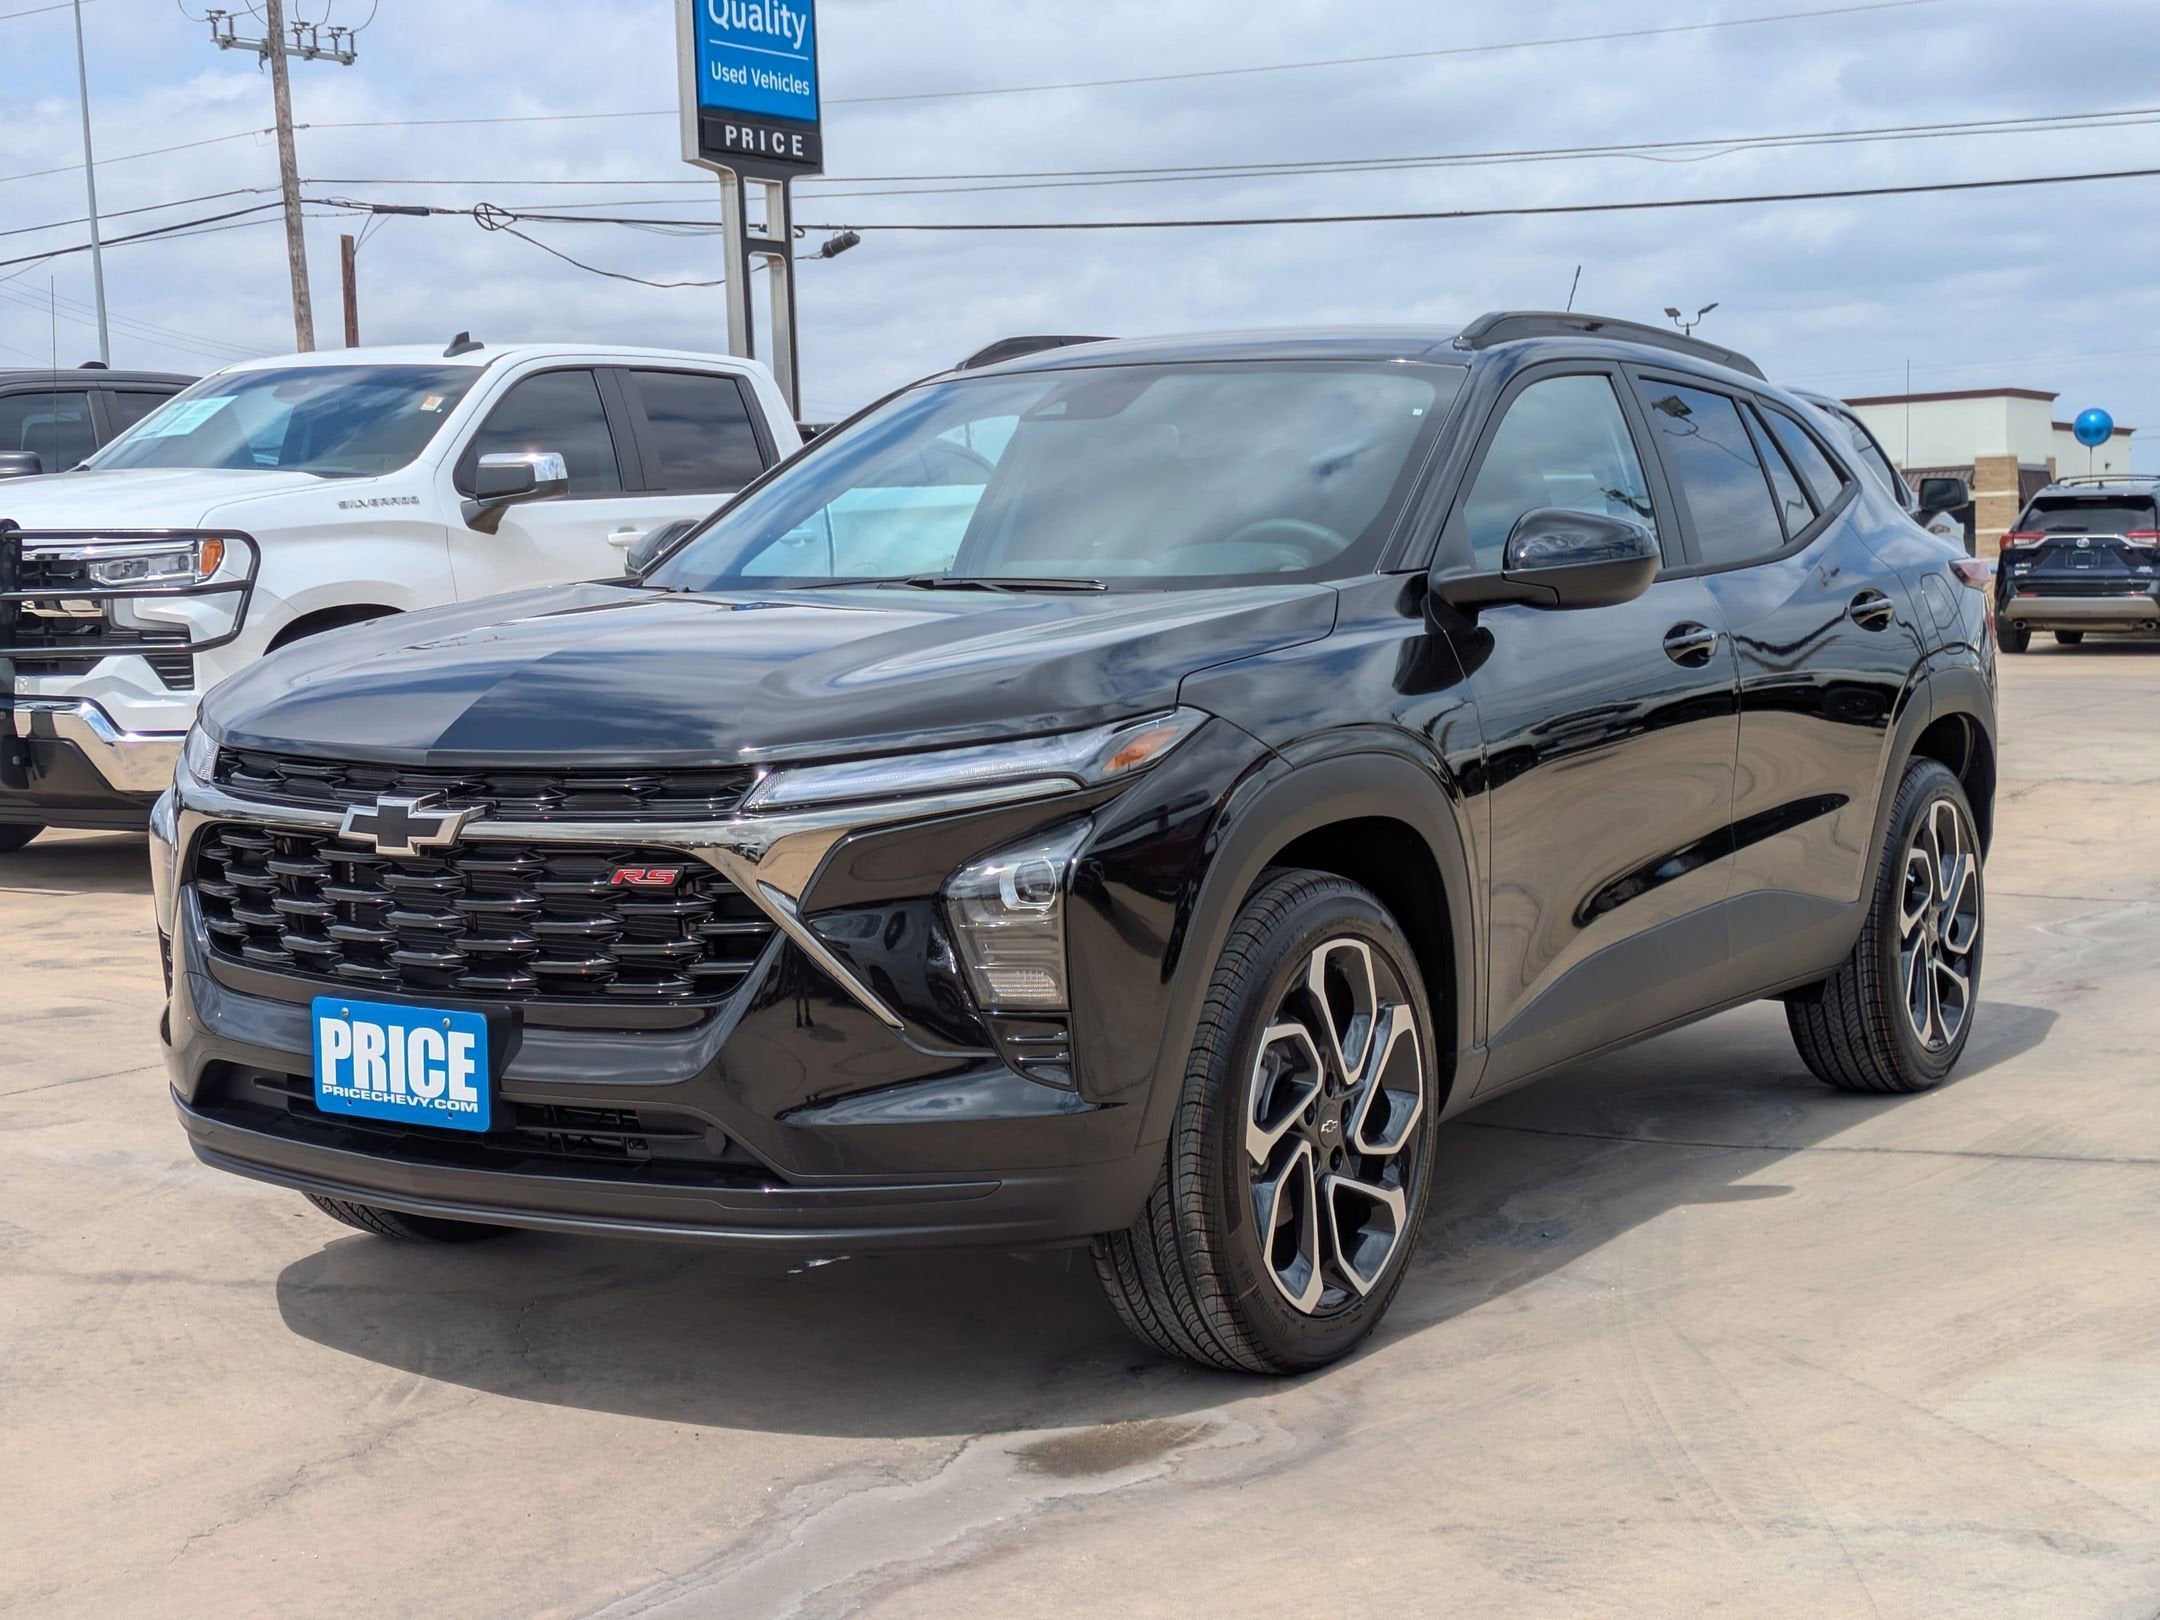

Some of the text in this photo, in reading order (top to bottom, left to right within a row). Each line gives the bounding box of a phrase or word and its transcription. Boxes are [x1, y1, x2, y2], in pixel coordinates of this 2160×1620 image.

[708, 0, 807, 50] Quality
[711, 60, 810, 96] Used Vehicles
[725, 125, 804, 157] PRICE
[337, 495, 421, 510] SILVERADO
[611, 868, 679, 885] RS
[319, 1016, 479, 1102] PRICE
[322, 1084, 479, 1113] PRICECHEVY.COM
